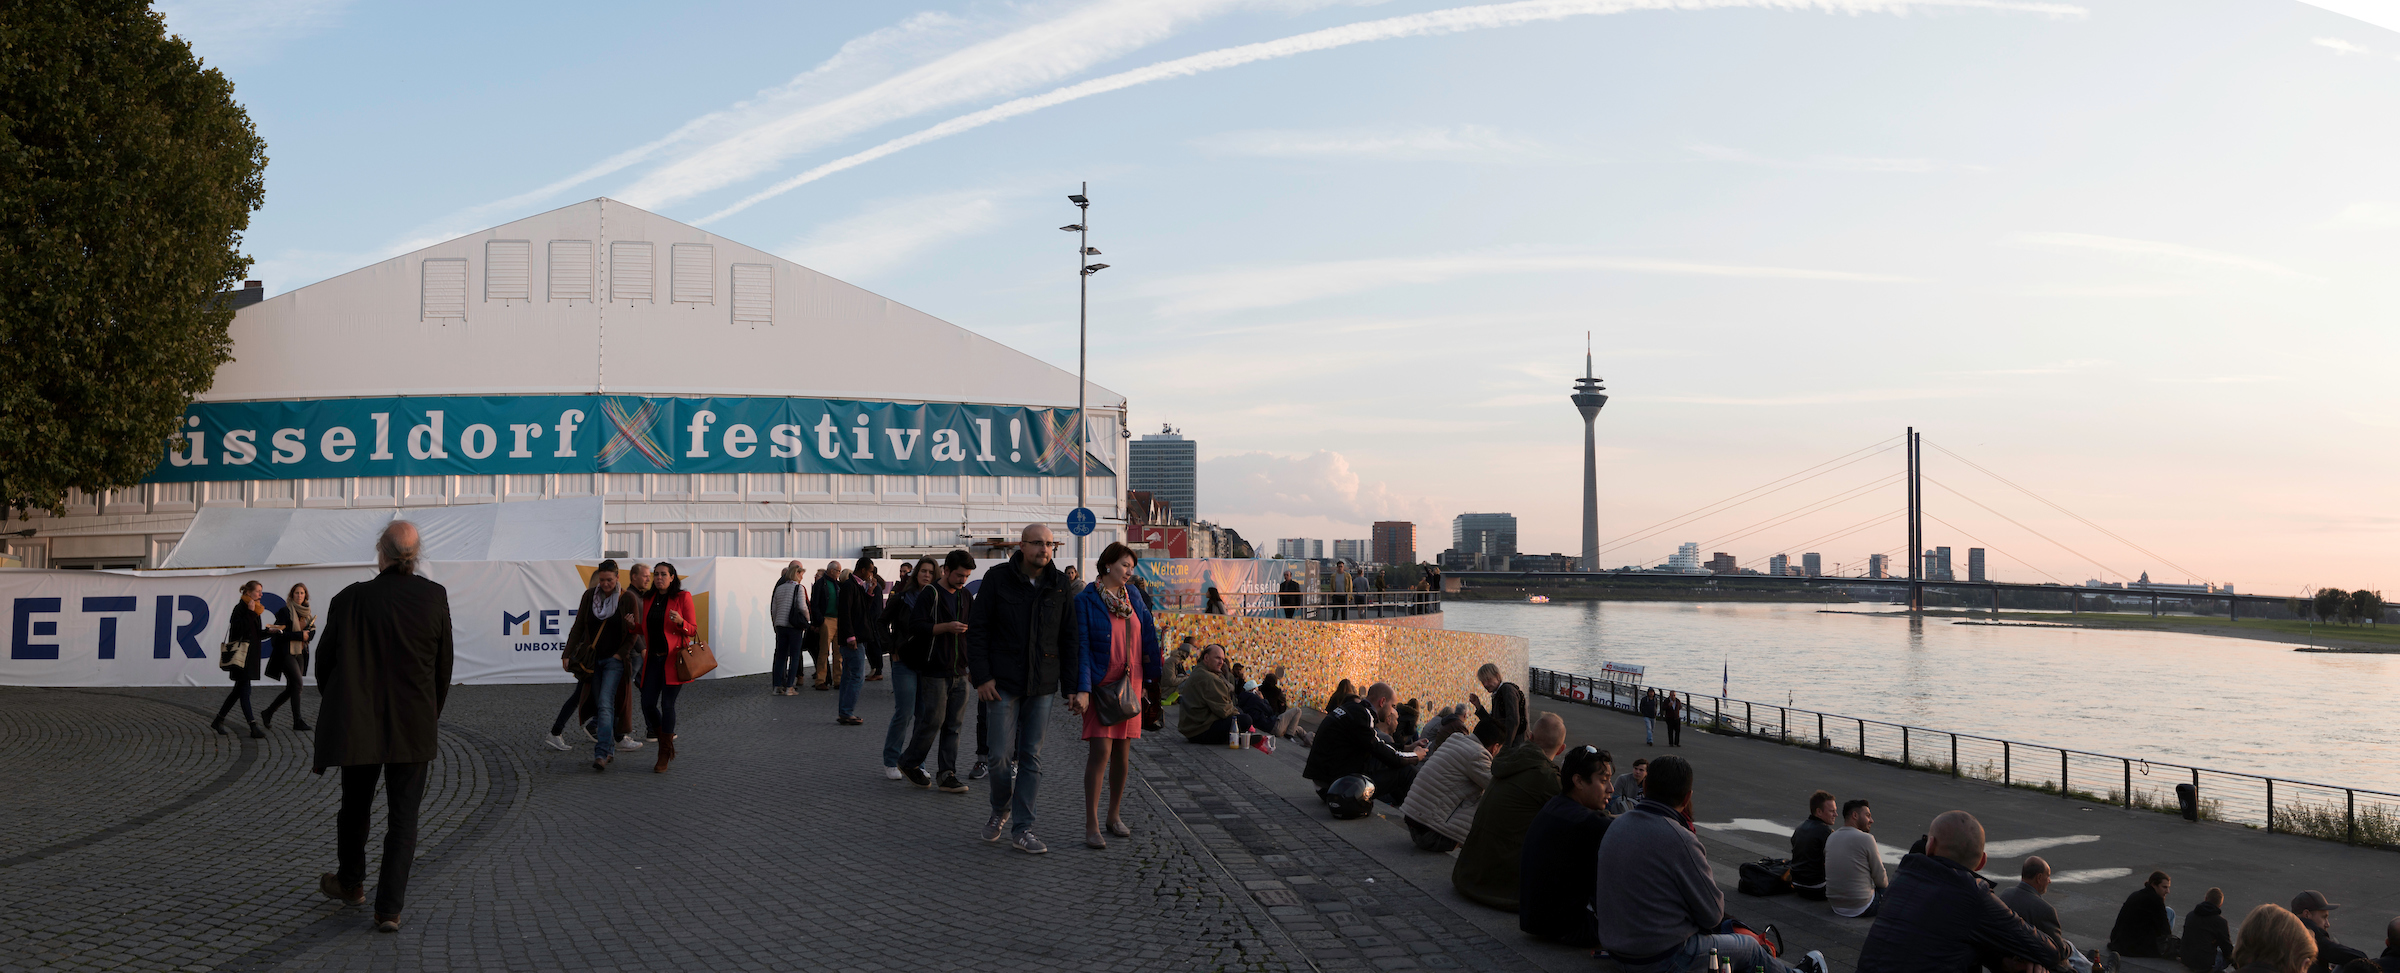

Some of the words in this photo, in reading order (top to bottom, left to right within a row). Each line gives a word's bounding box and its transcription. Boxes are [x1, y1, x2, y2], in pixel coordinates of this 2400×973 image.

[167, 408, 585, 468] üsseldorf
[685, 410, 1022, 463] festival!
[1240, 579, 1281, 594] düsseldo
[11, 592, 289, 660] ETR
[514, 642, 567, 652] UNBOXE
